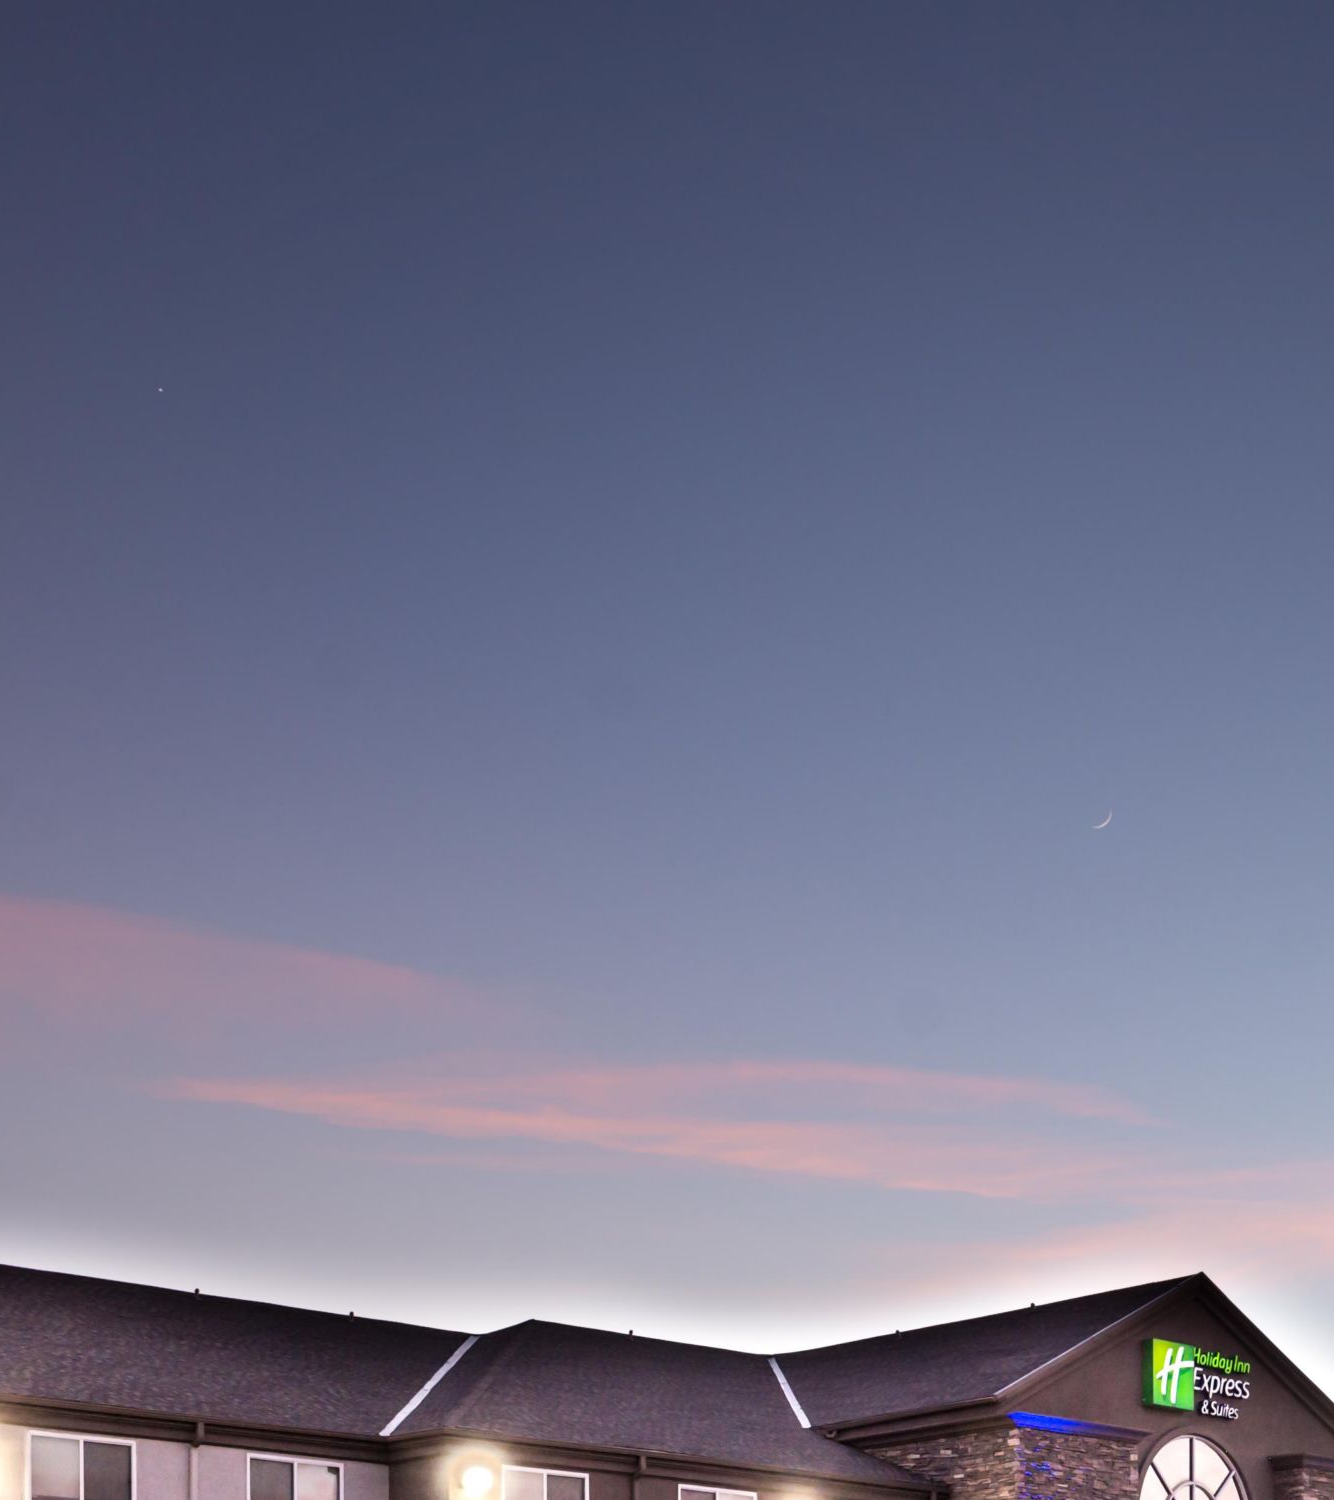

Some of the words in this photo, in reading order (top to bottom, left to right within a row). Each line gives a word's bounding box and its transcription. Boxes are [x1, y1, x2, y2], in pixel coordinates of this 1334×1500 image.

[1194, 1347, 1233, 1374] Holiday
[1234, 1355, 1250, 1374] Inn
[1194, 1367, 1250, 1399] Express
[1201, 1400, 1209, 1415] &
[1210, 1401, 1239, 1419] Suites
